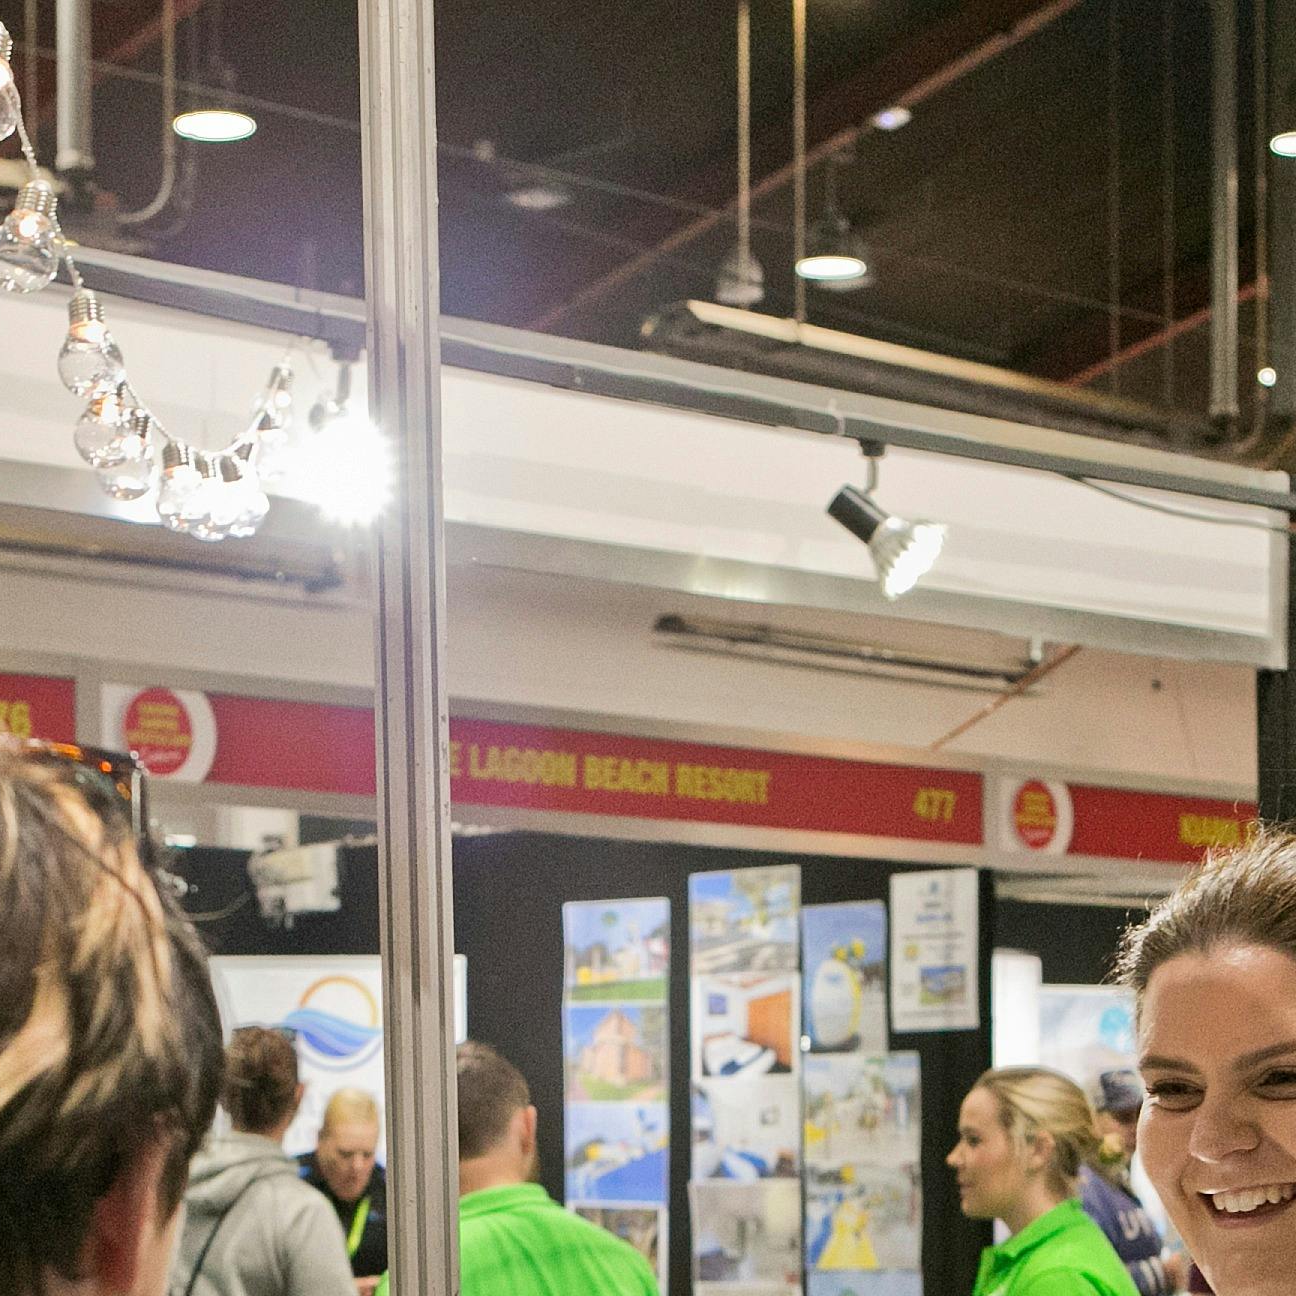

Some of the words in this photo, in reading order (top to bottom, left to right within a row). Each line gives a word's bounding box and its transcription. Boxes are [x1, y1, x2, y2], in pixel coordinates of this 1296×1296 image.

[469, 745, 576, 788] LAGOON
[584, 754, 668, 796] BEACH
[675, 763, 771, 805] RESORT
